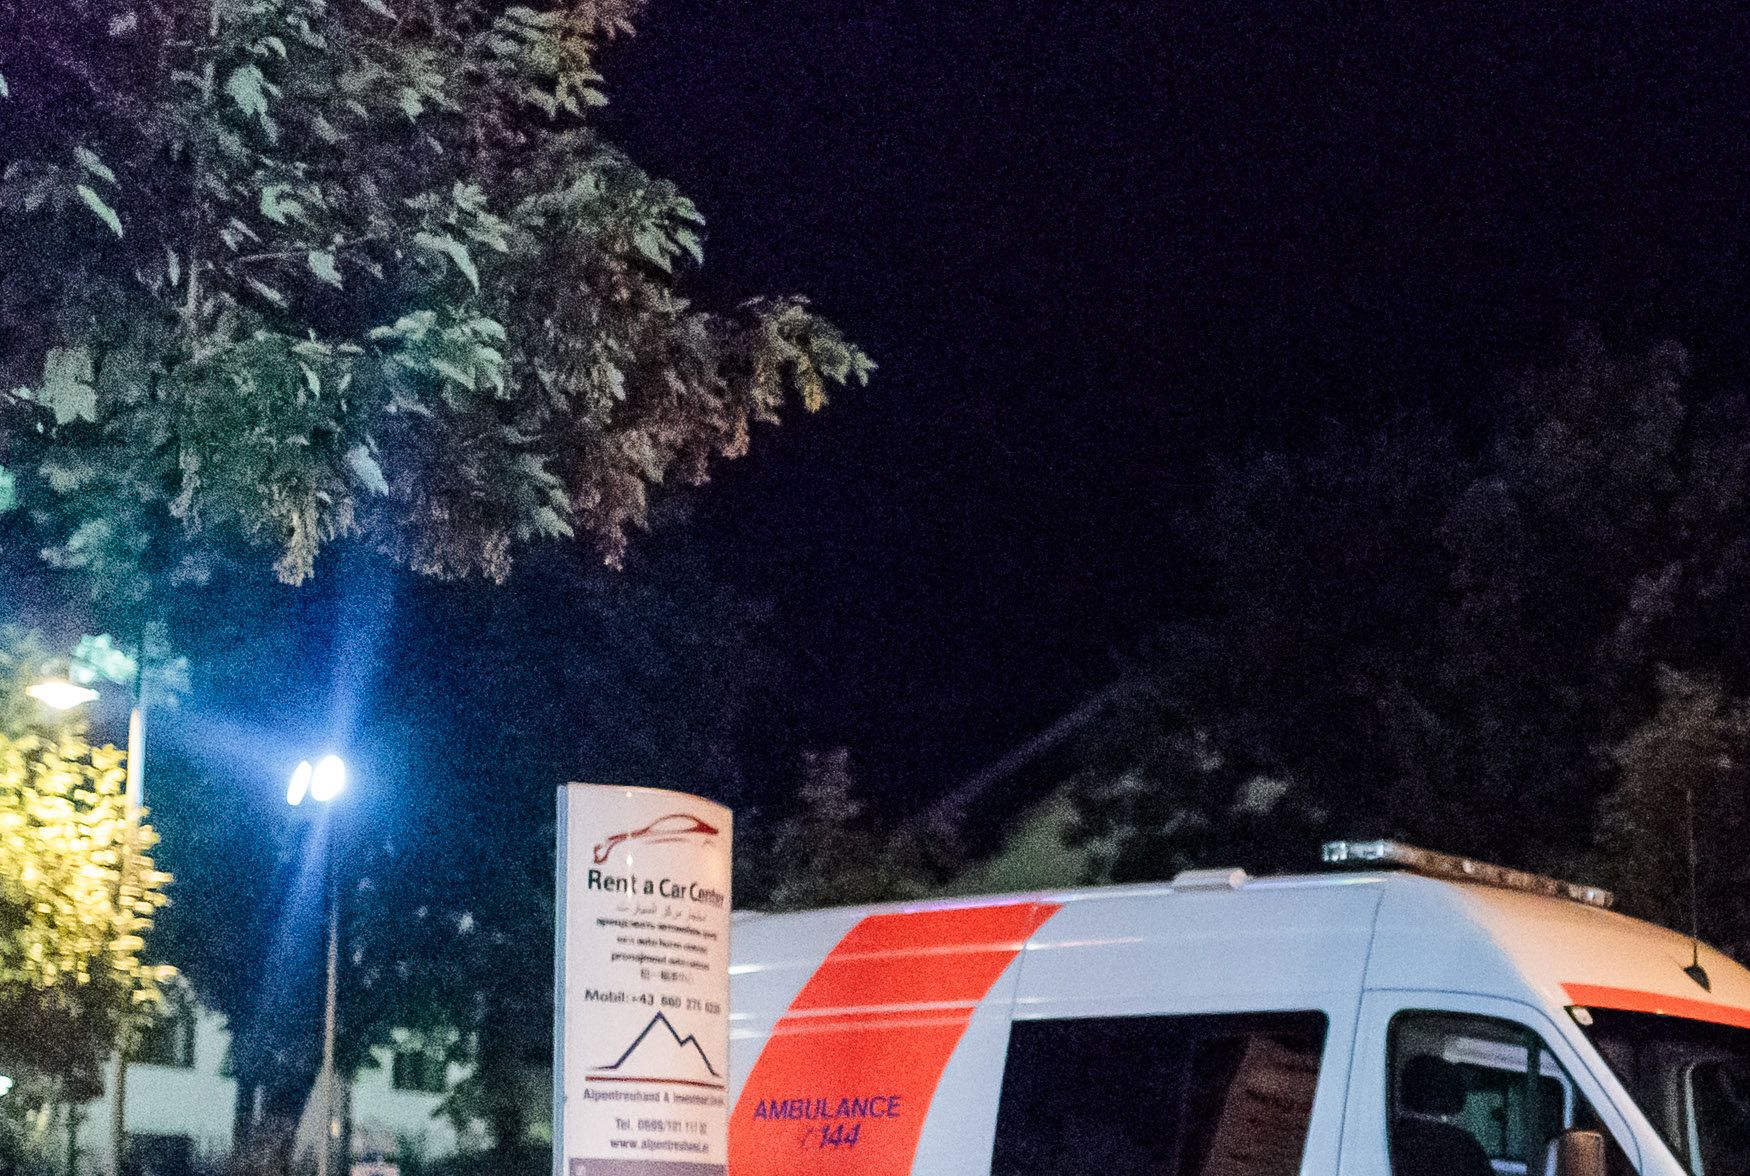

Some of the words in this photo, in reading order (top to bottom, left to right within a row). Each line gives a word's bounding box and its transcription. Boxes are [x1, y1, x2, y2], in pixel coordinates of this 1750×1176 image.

[588, 869, 638, 894] Rent
[643, 878, 654, 896] a
[659, 878, 687, 899] Car
[753, 1095, 902, 1120] AMBULANCE
[820, 1123, 861, 1148] 144
